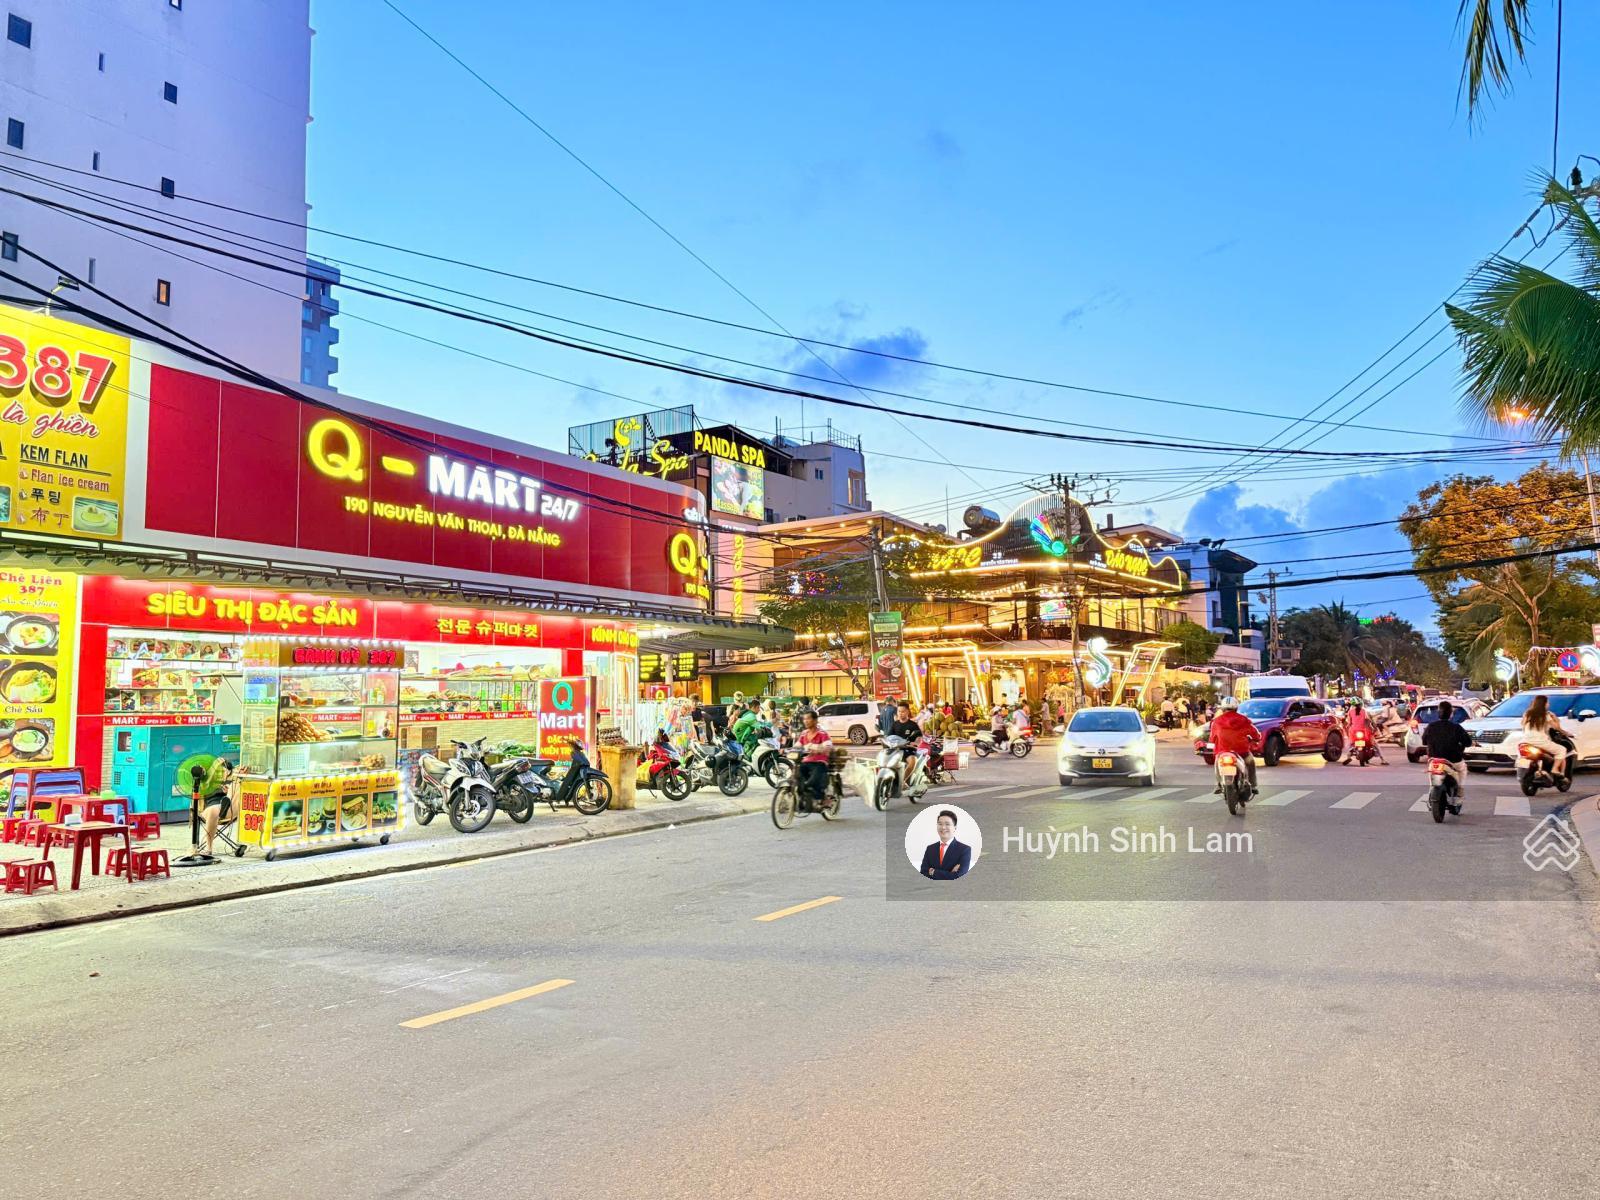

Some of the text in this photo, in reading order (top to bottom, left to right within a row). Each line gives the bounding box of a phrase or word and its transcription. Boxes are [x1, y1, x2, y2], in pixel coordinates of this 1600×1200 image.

[0, 333, 113, 406] 387
[20, 443, 49, 463] KEM
[55, 449, 88, 469] FLAN
[694, 431, 766, 468] PANDA SPA
[31, 468, 110, 492] Flan ice cream
[308, 419, 363, 482] Q
[429, 455, 541, 513] MART
[541, 494, 579, 521] 24/7
[345, 496, 368, 513] 190
[373, 502, 434, 526] NGUYỄN
[437, 512, 464, 530] VĂN
[508, 524, 525, 541] ĐÀ
[528, 526, 561, 546] NẴNG
[671, 533, 697, 577] Q
[20, 585, 45, 595] 387
[31, 574, 62, 586] Liên
[147, 590, 358, 630] SIÊU THỊ ĐẶC SẢN
[437, 617, 538, 639] 전문 슈퍼마켓
[591, 625, 617, 643] KÍNH
[877, 639, 890, 648] 149
[368, 650, 396, 666] 387
[551, 681, 574, 711] Q
[112, 716, 139, 725] MART
[175, 715, 182, 724] Q
[188, 716, 212, 724] MART
[317, 713, 338, 721] MART
[540, 712, 585, 729] Mart
[242, 793, 267, 812] BREA
